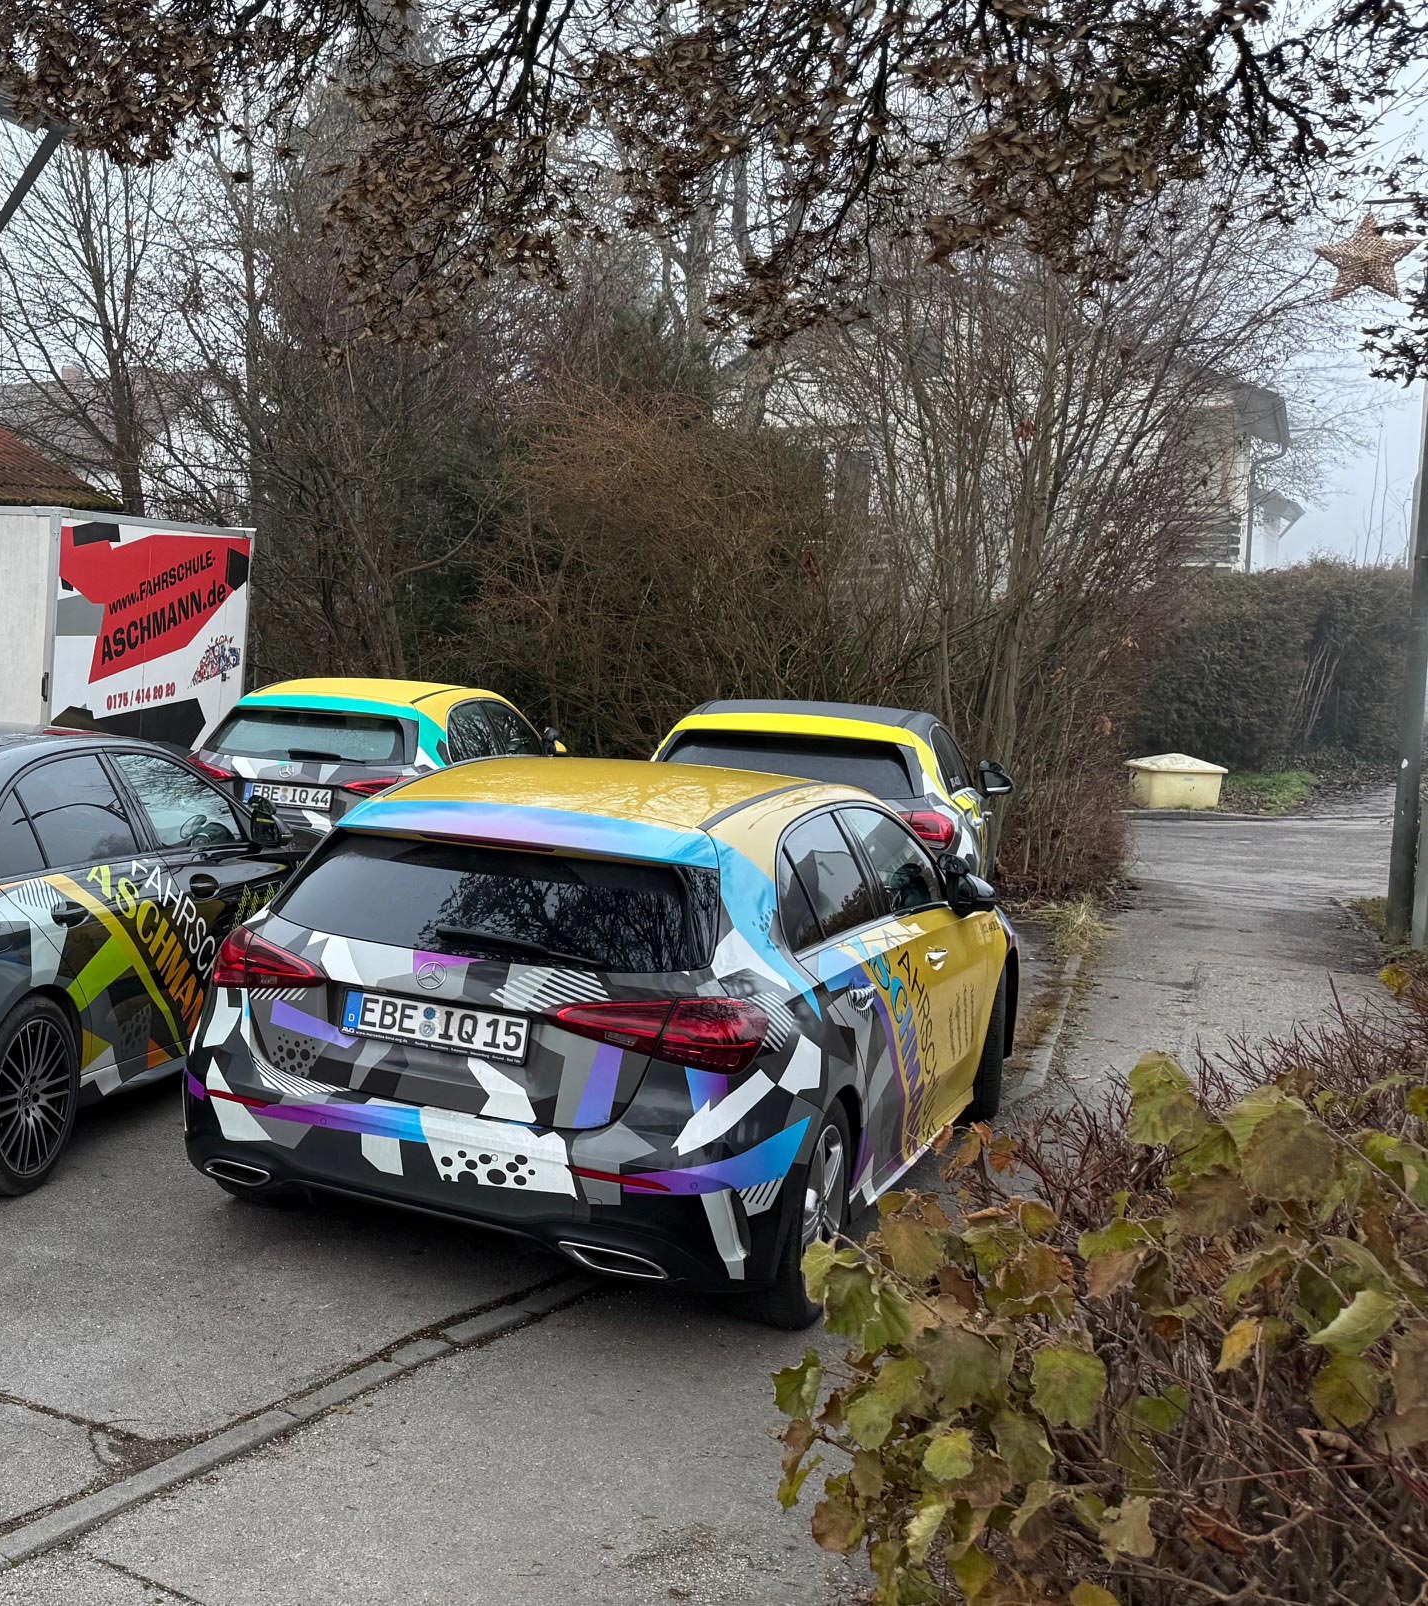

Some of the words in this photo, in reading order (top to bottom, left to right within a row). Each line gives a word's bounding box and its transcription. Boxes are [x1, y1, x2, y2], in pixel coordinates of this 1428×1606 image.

[101, 580, 226, 666] ASCHMANN.de
[106, 694, 129, 711] 0175
[135, 687, 152, 704] 414
[153, 684, 164, 700] 20
[165, 681, 176, 698] 20
[253, 785, 281, 802] EBE
[289, 788, 309, 804] IQ
[311, 790, 329, 807] 44
[348, 1013, 355, 1022] D
[360, 997, 418, 1034] EBE
[438, 1010, 478, 1044] IQ
[483, 1018, 524, 1051] 15
